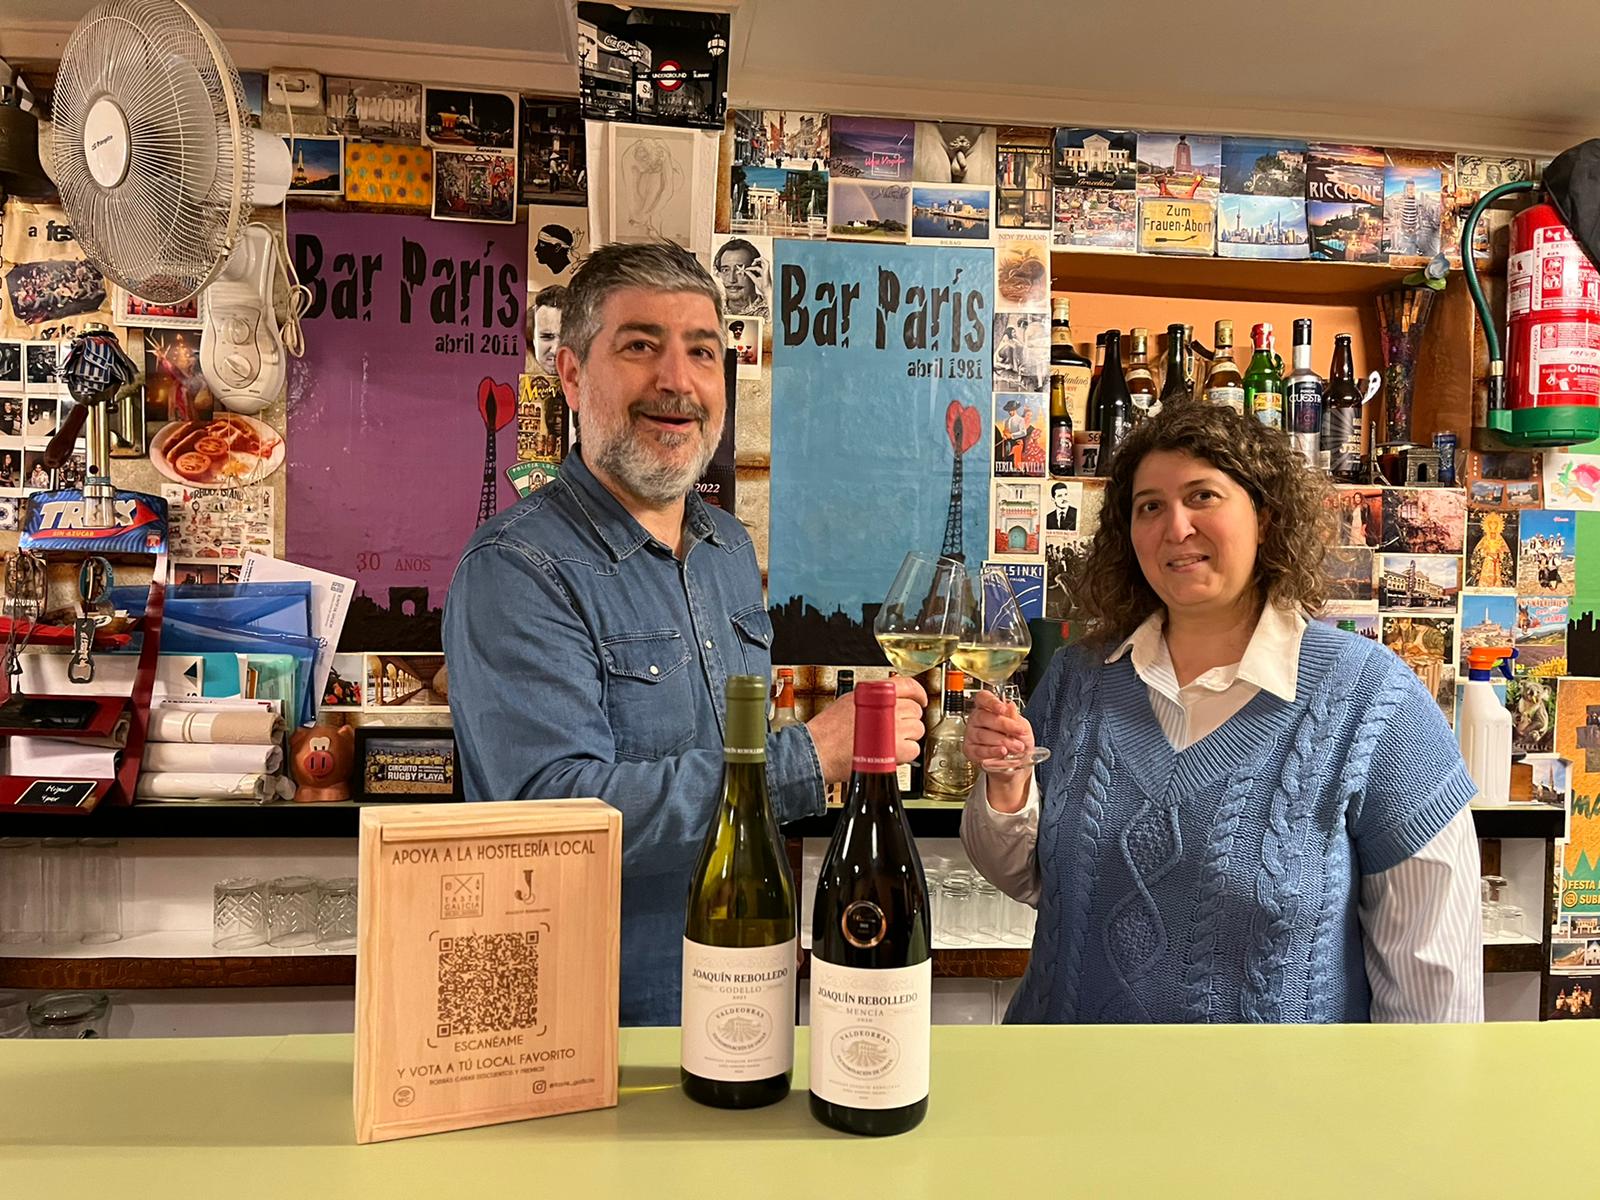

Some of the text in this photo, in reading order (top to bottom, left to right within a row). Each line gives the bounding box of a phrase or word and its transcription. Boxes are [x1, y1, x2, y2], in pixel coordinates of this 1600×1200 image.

[1074, 178, 1116, 188] Graceland
[1308, 181, 1383, 202] RICCIONE
[1166, 205, 1191, 217] Zum
[28, 226, 38, 238] a
[1143, 217, 1212, 233] Frauen-Abort
[999, 233, 1048, 242] NEW ZEALAND
[296, 234, 519, 328] Bar París
[781, 264, 985, 353] Bar París
[435, 333, 519, 356] abril 2011
[907, 358, 983, 380] abril 1981
[694, 483, 721, 493] 2022
[356, 552, 381, 572] 30
[387, 772, 445, 781] RUGBY PLAYA
[392, 840, 596, 865] APOYA A LA HOSTELERÍA LOCAL
[1568, 880, 1596, 890] FESTA
[692, 967, 788, 984] JOAQUÍN REBOLLEDO
[719, 986, 762, 994] GODELLO
[817, 986, 918, 1006] JOAQUÍN REBOLLEDO
[846, 1007, 884, 1017] MENCÍA
[454, 1034, 524, 1053] ESCANÉAME
[839, 1030, 891, 1044] VALDEORRAS
[397, 1048, 576, 1079] Y VOTA A TÚ LOCAL FAVORITO
